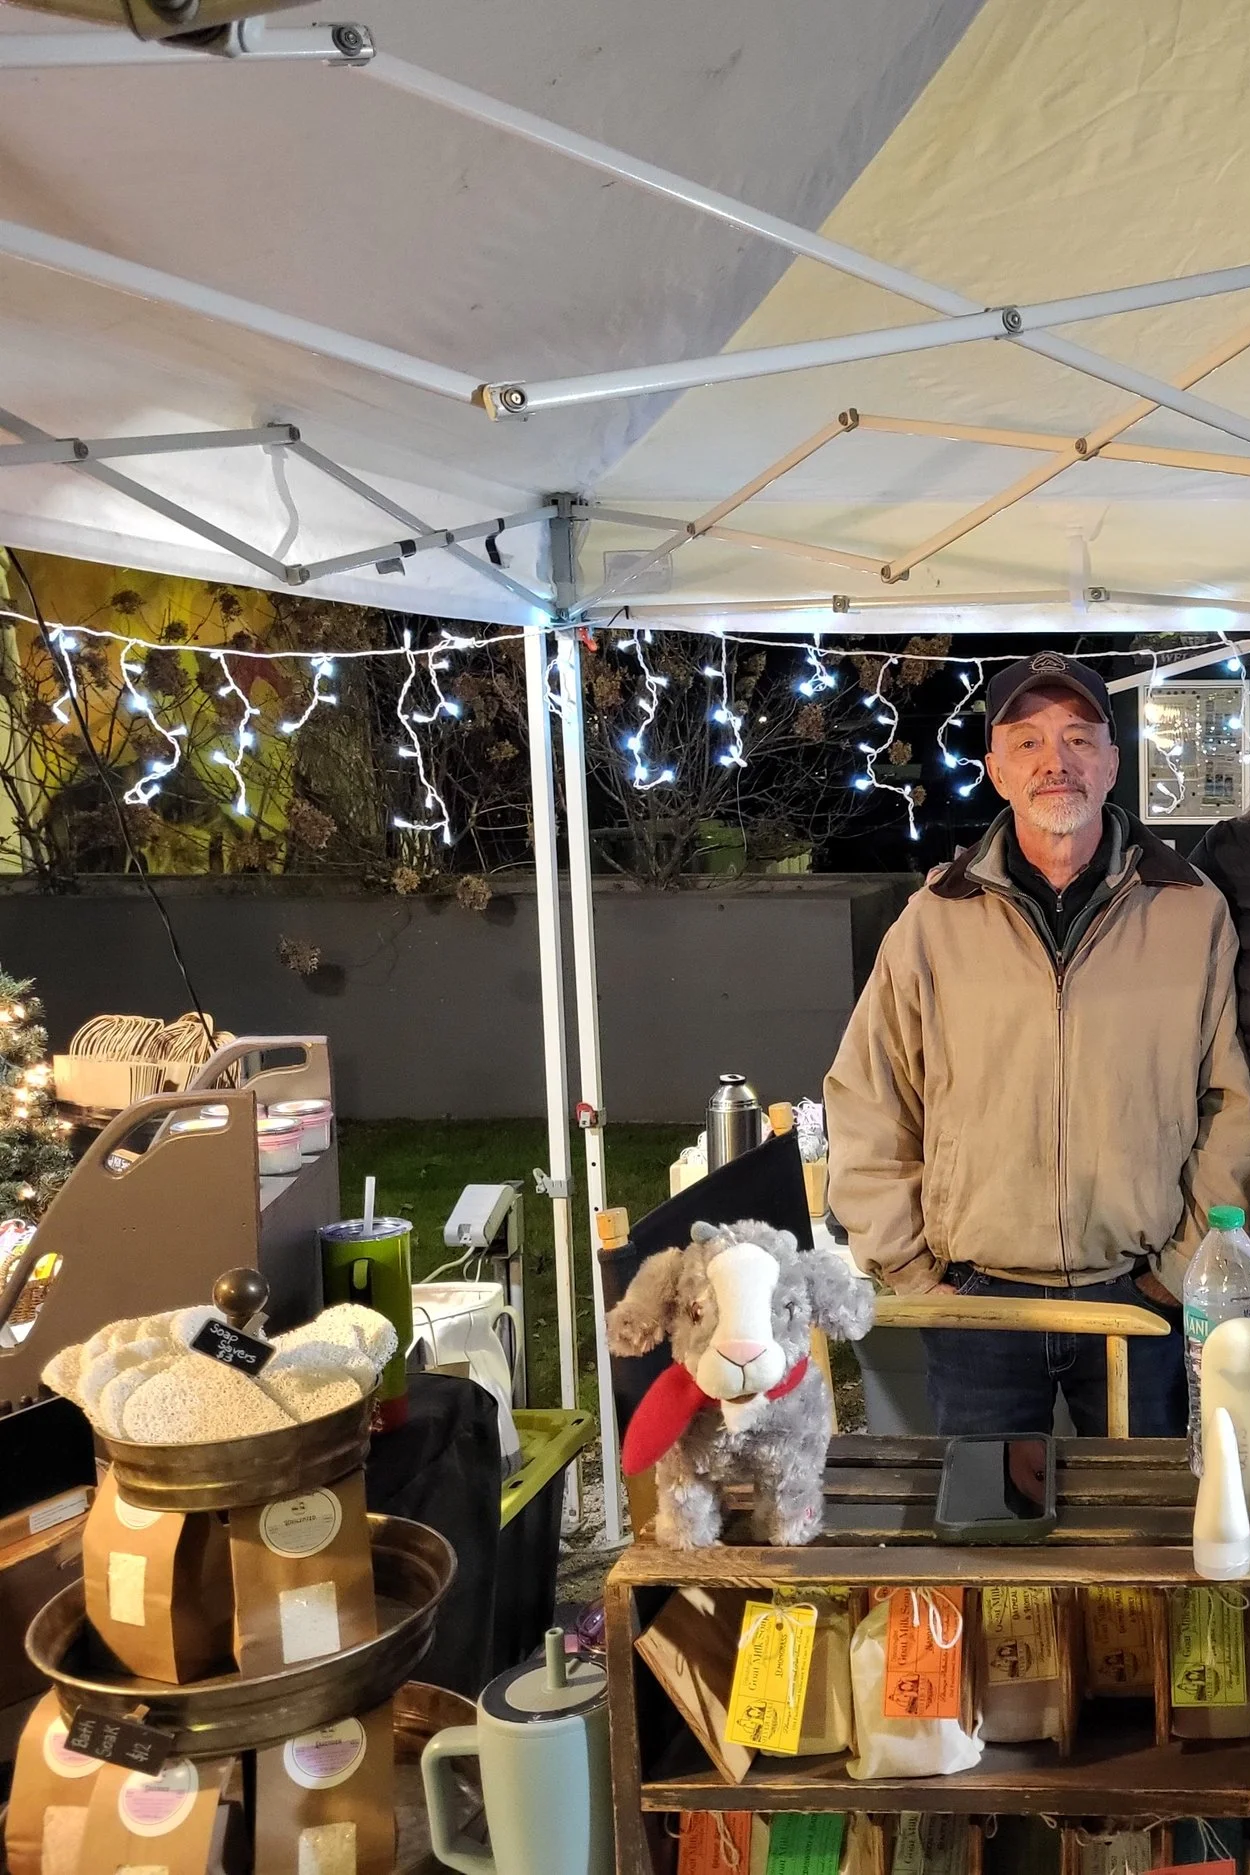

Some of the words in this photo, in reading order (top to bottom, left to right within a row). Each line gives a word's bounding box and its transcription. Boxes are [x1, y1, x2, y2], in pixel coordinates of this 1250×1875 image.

[209, 1324, 238, 1345] Soap
[216, 1350, 233, 1362] $3
[218, 1339, 256, 1363] Savers
[899, 1617, 909, 1639] Milk
[751, 1641, 764, 1664] Milk
[898, 1642, 908, 1666] Goat
[747, 1665, 759, 1691] Goat
[70, 1720, 96, 1748] Bath
[95, 1724, 120, 1757] Soak
